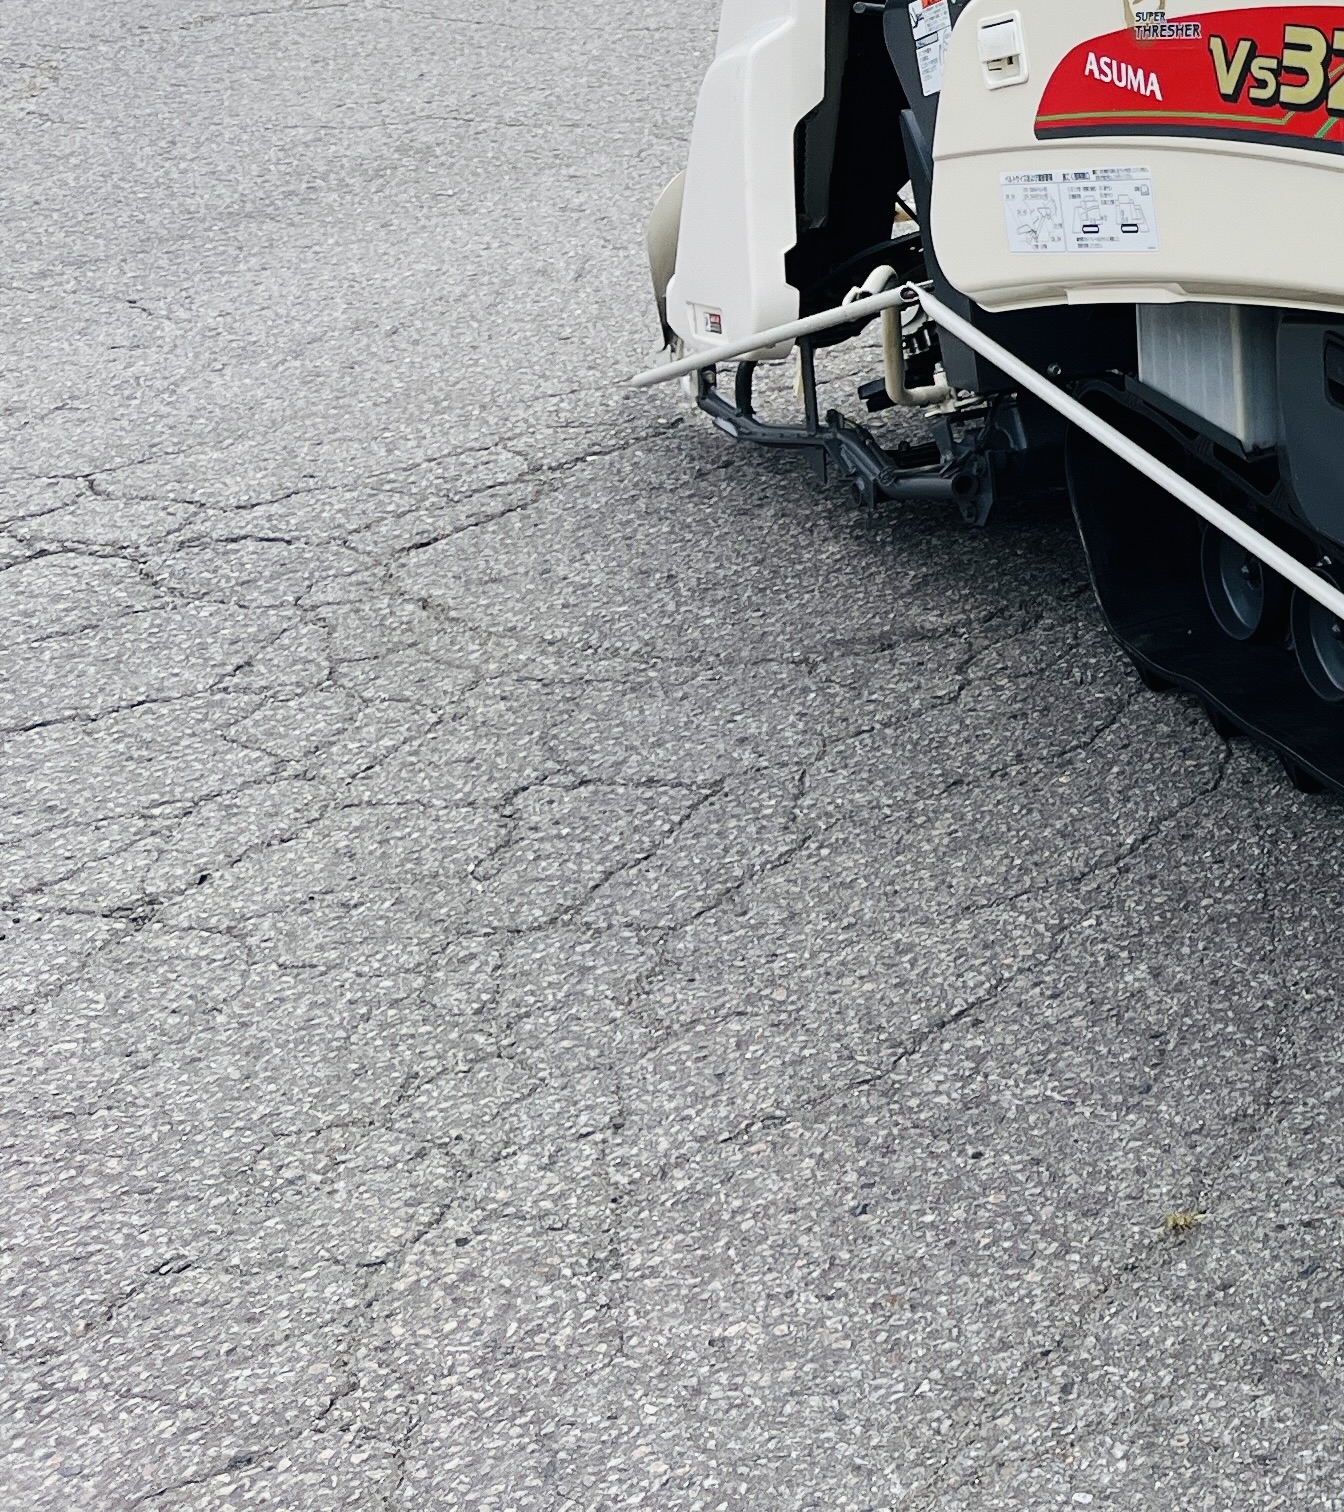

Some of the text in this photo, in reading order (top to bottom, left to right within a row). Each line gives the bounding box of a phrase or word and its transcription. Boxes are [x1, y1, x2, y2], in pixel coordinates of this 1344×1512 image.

[1135, 11, 1167, 23] SUPER
[1135, 23, 1201, 38] THRESHER
[1084, 52, 1163, 102] ASUMA
